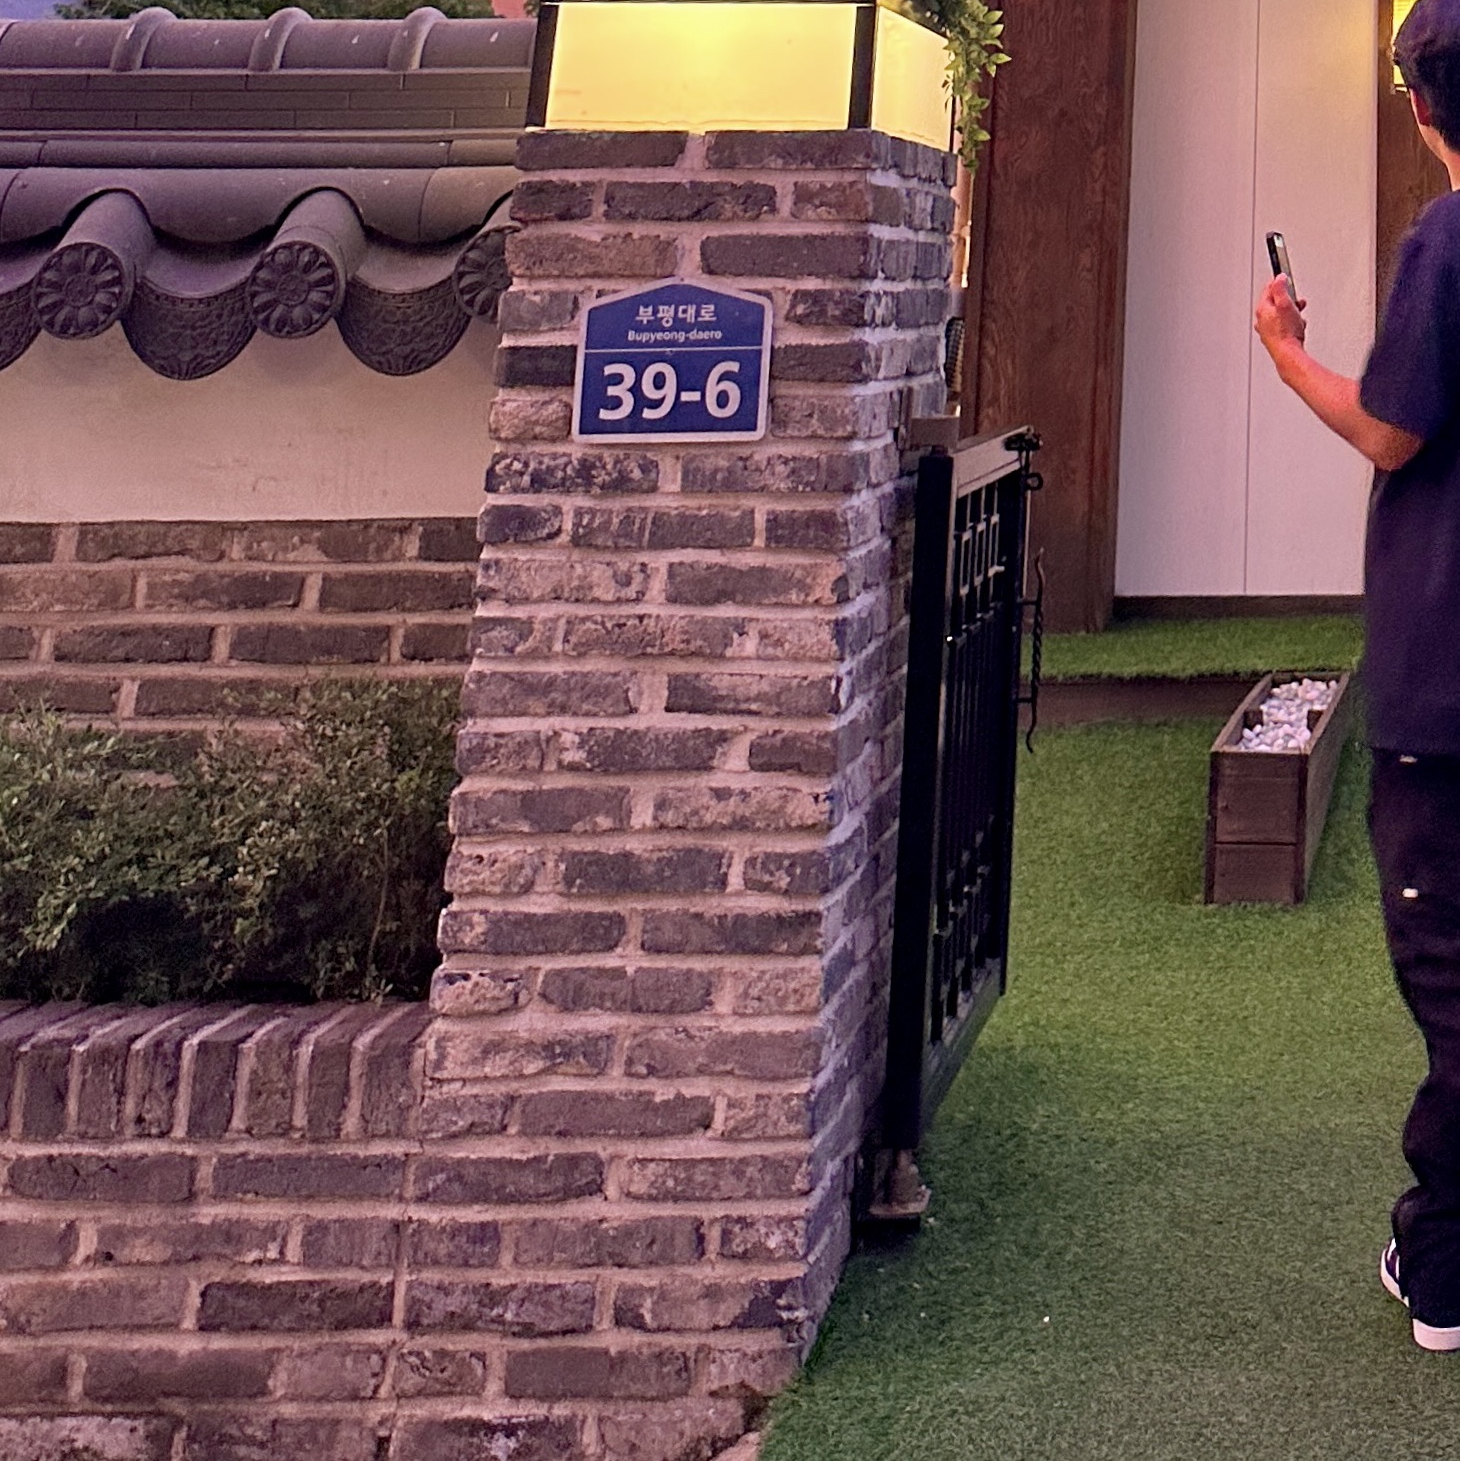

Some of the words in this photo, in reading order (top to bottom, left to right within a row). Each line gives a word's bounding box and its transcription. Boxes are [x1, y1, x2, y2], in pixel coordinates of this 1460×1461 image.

[635, 304, 717, 327] 부평대로
[627, 329, 722, 343] Bupyeong-daero
[598, 360, 742, 420] 39-6
